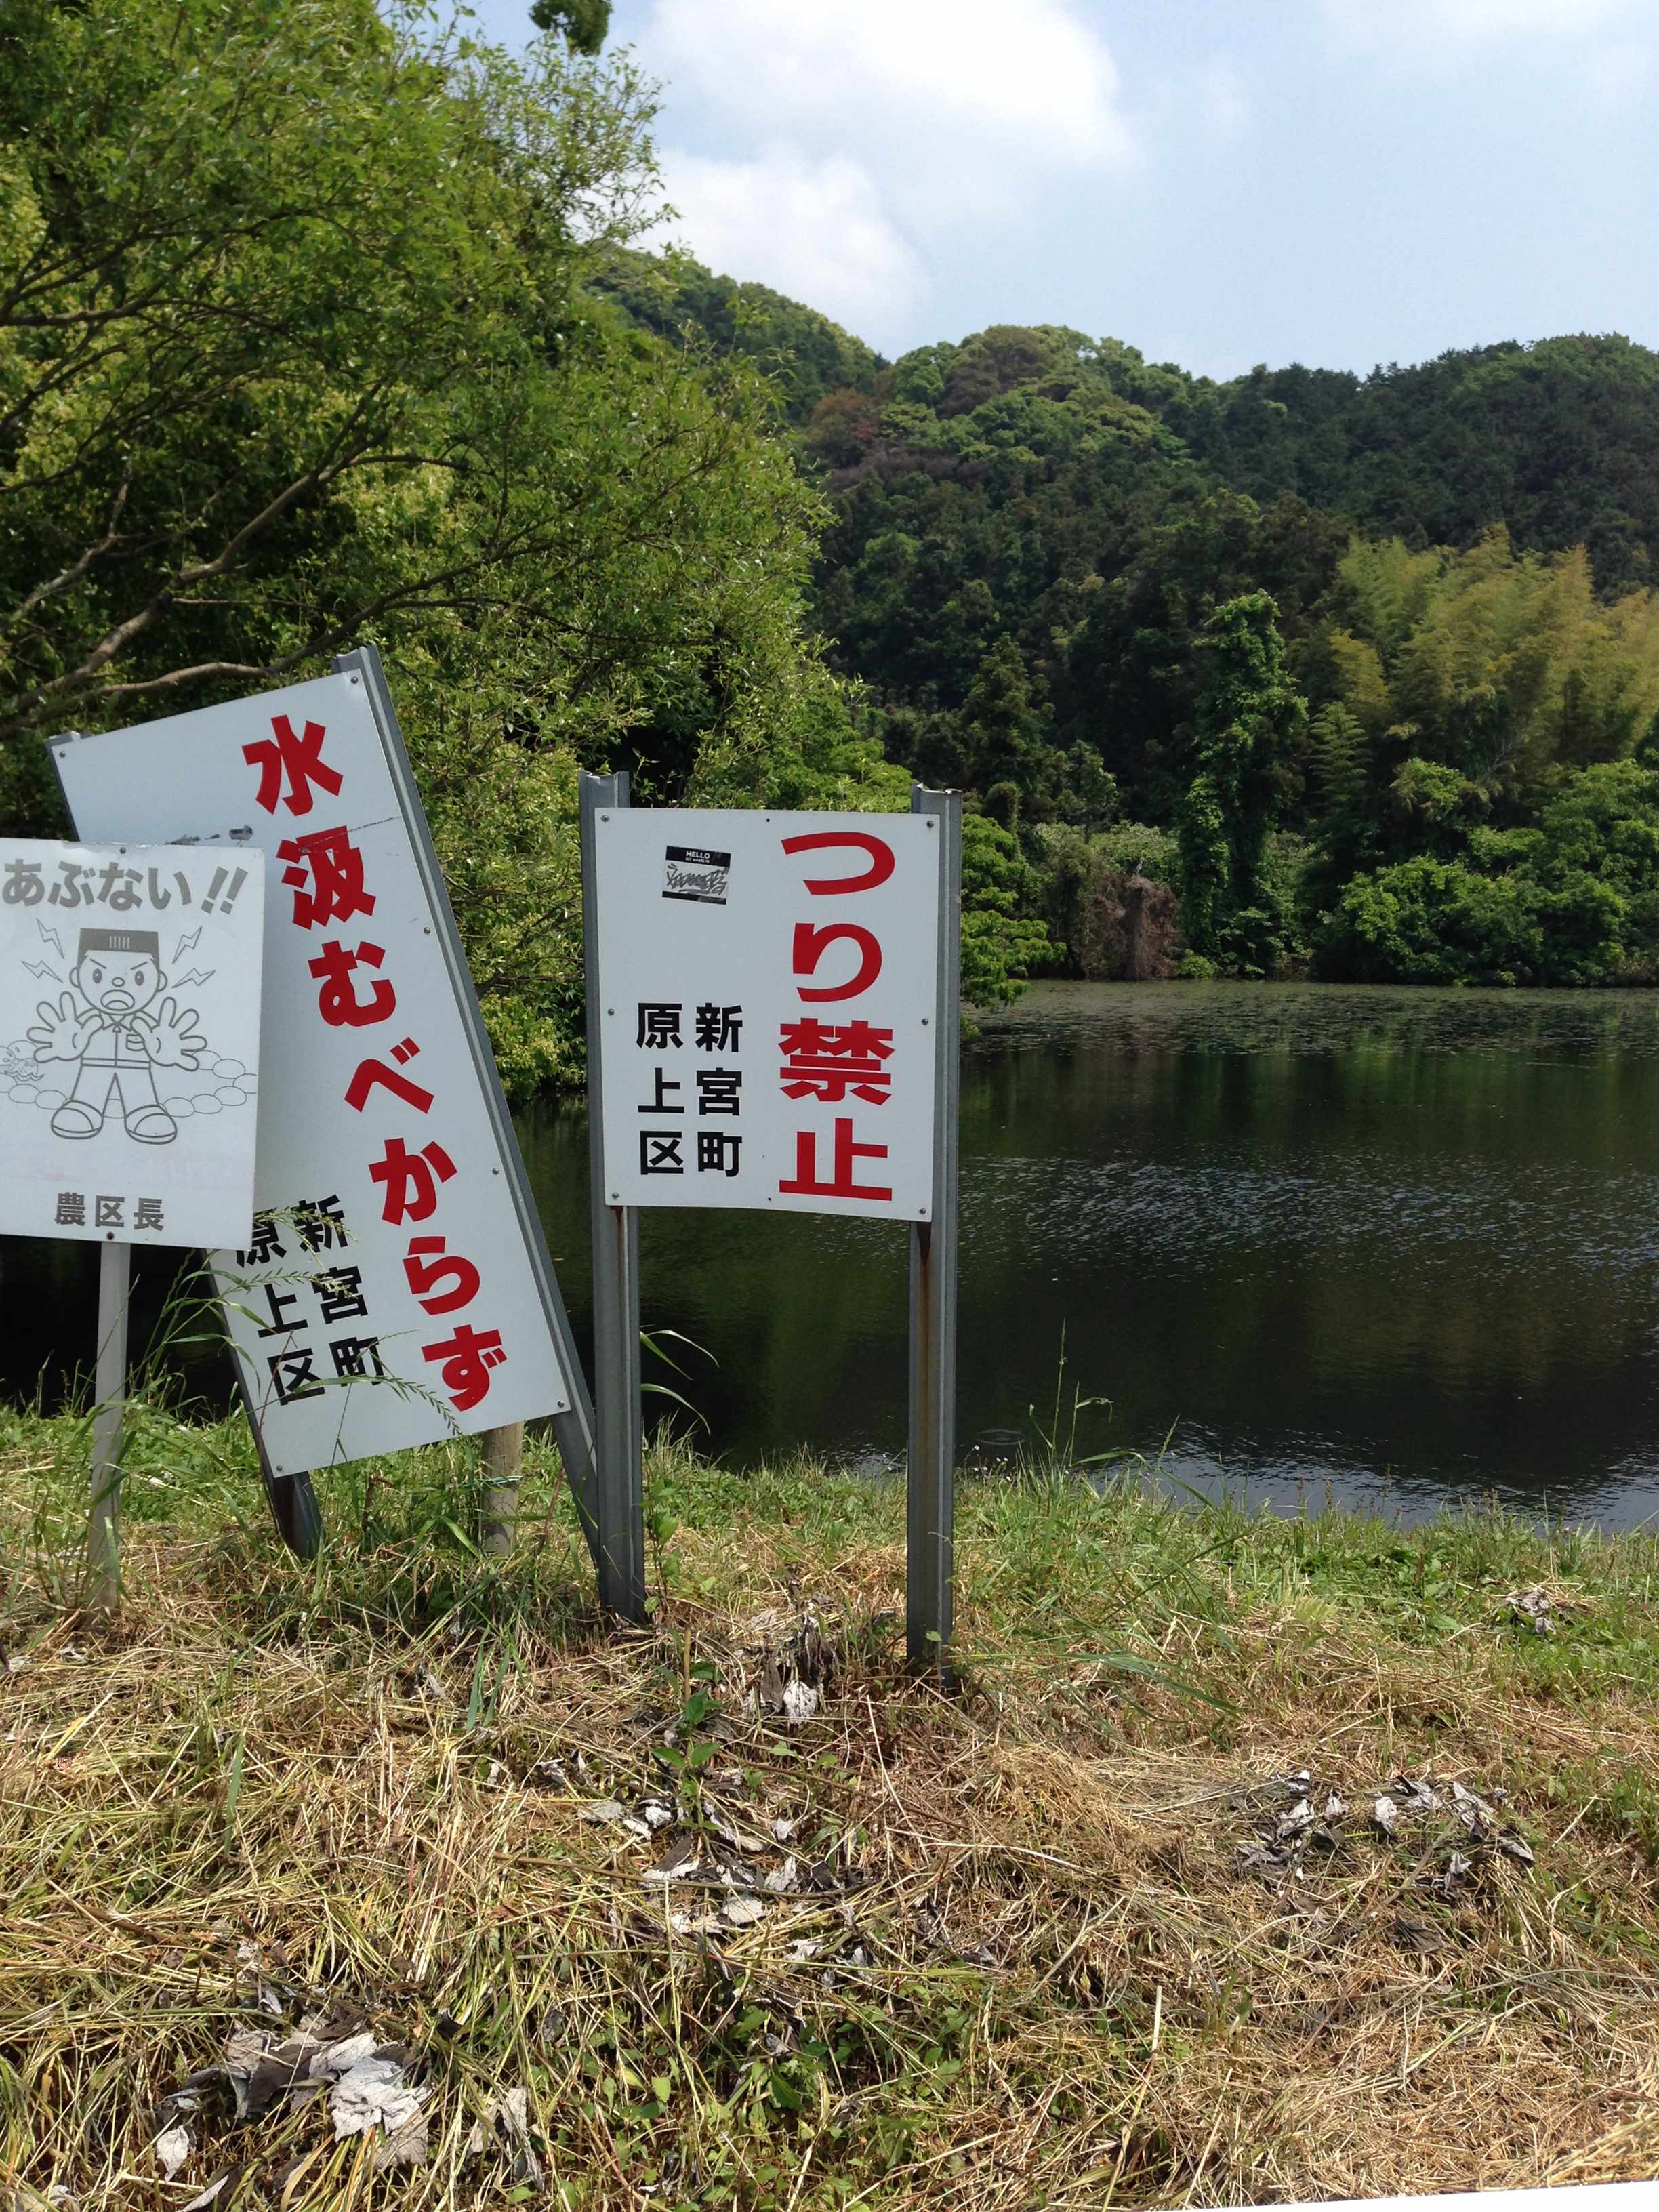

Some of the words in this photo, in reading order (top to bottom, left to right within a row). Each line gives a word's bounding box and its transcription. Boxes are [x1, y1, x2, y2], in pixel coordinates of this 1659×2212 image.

[685, 851, 710, 859] HELLO
[242, 714, 508, 1411] 水汲むべからず
[636, 1002, 684, 1176] 原上区
[695, 1002, 743, 1177] 新宮町
[779, 832, 895, 1201] つり禁止
[54, 1192, 164, 1231] 農区長
